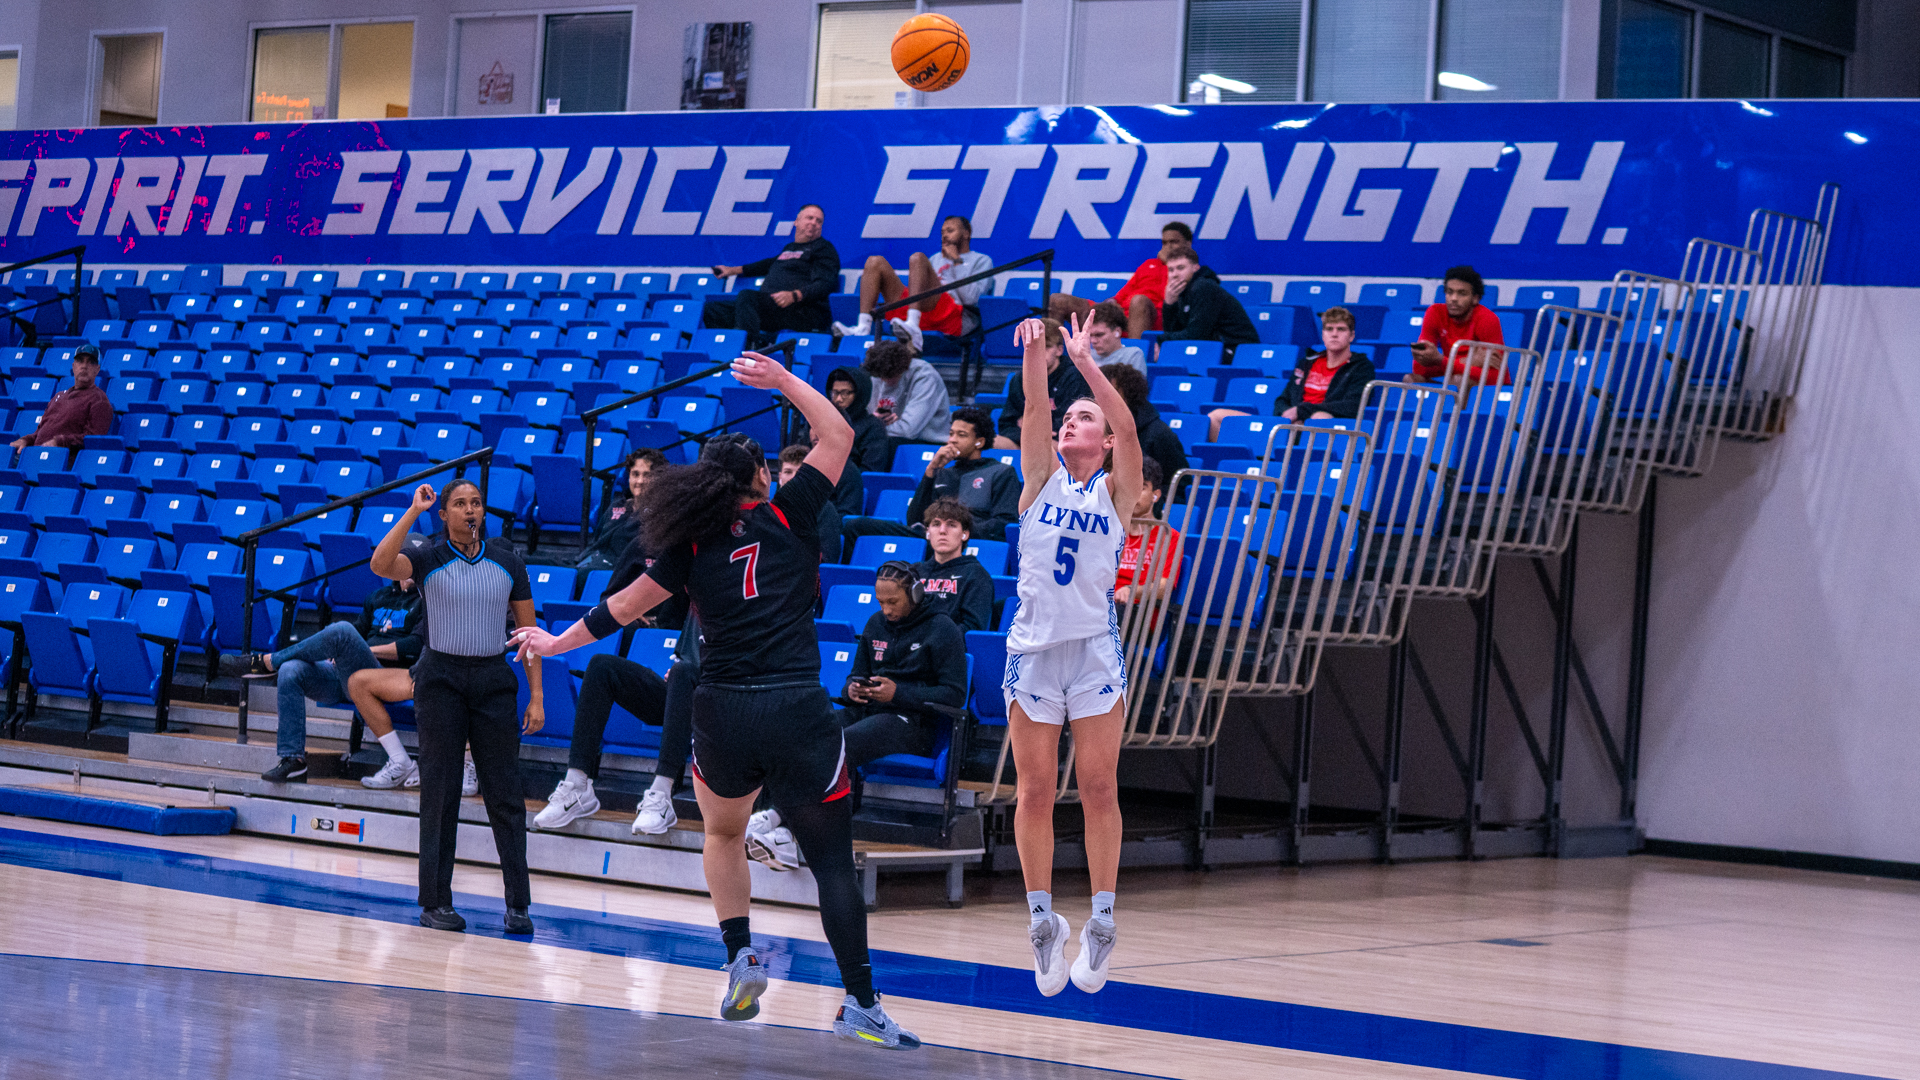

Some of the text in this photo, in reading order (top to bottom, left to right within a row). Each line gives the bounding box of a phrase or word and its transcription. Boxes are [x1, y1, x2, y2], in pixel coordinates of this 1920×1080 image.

[906, 62, 940, 86] NCAA
[321, 146, 795, 236] SERVICE.
[861, 141, 1628, 244] STRENGTH.
[1038, 502, 1110, 535] LYNN
[729, 541, 760, 600] 7
[1053, 535, 1080, 586] 5
[920, 578, 958, 595] MPA
